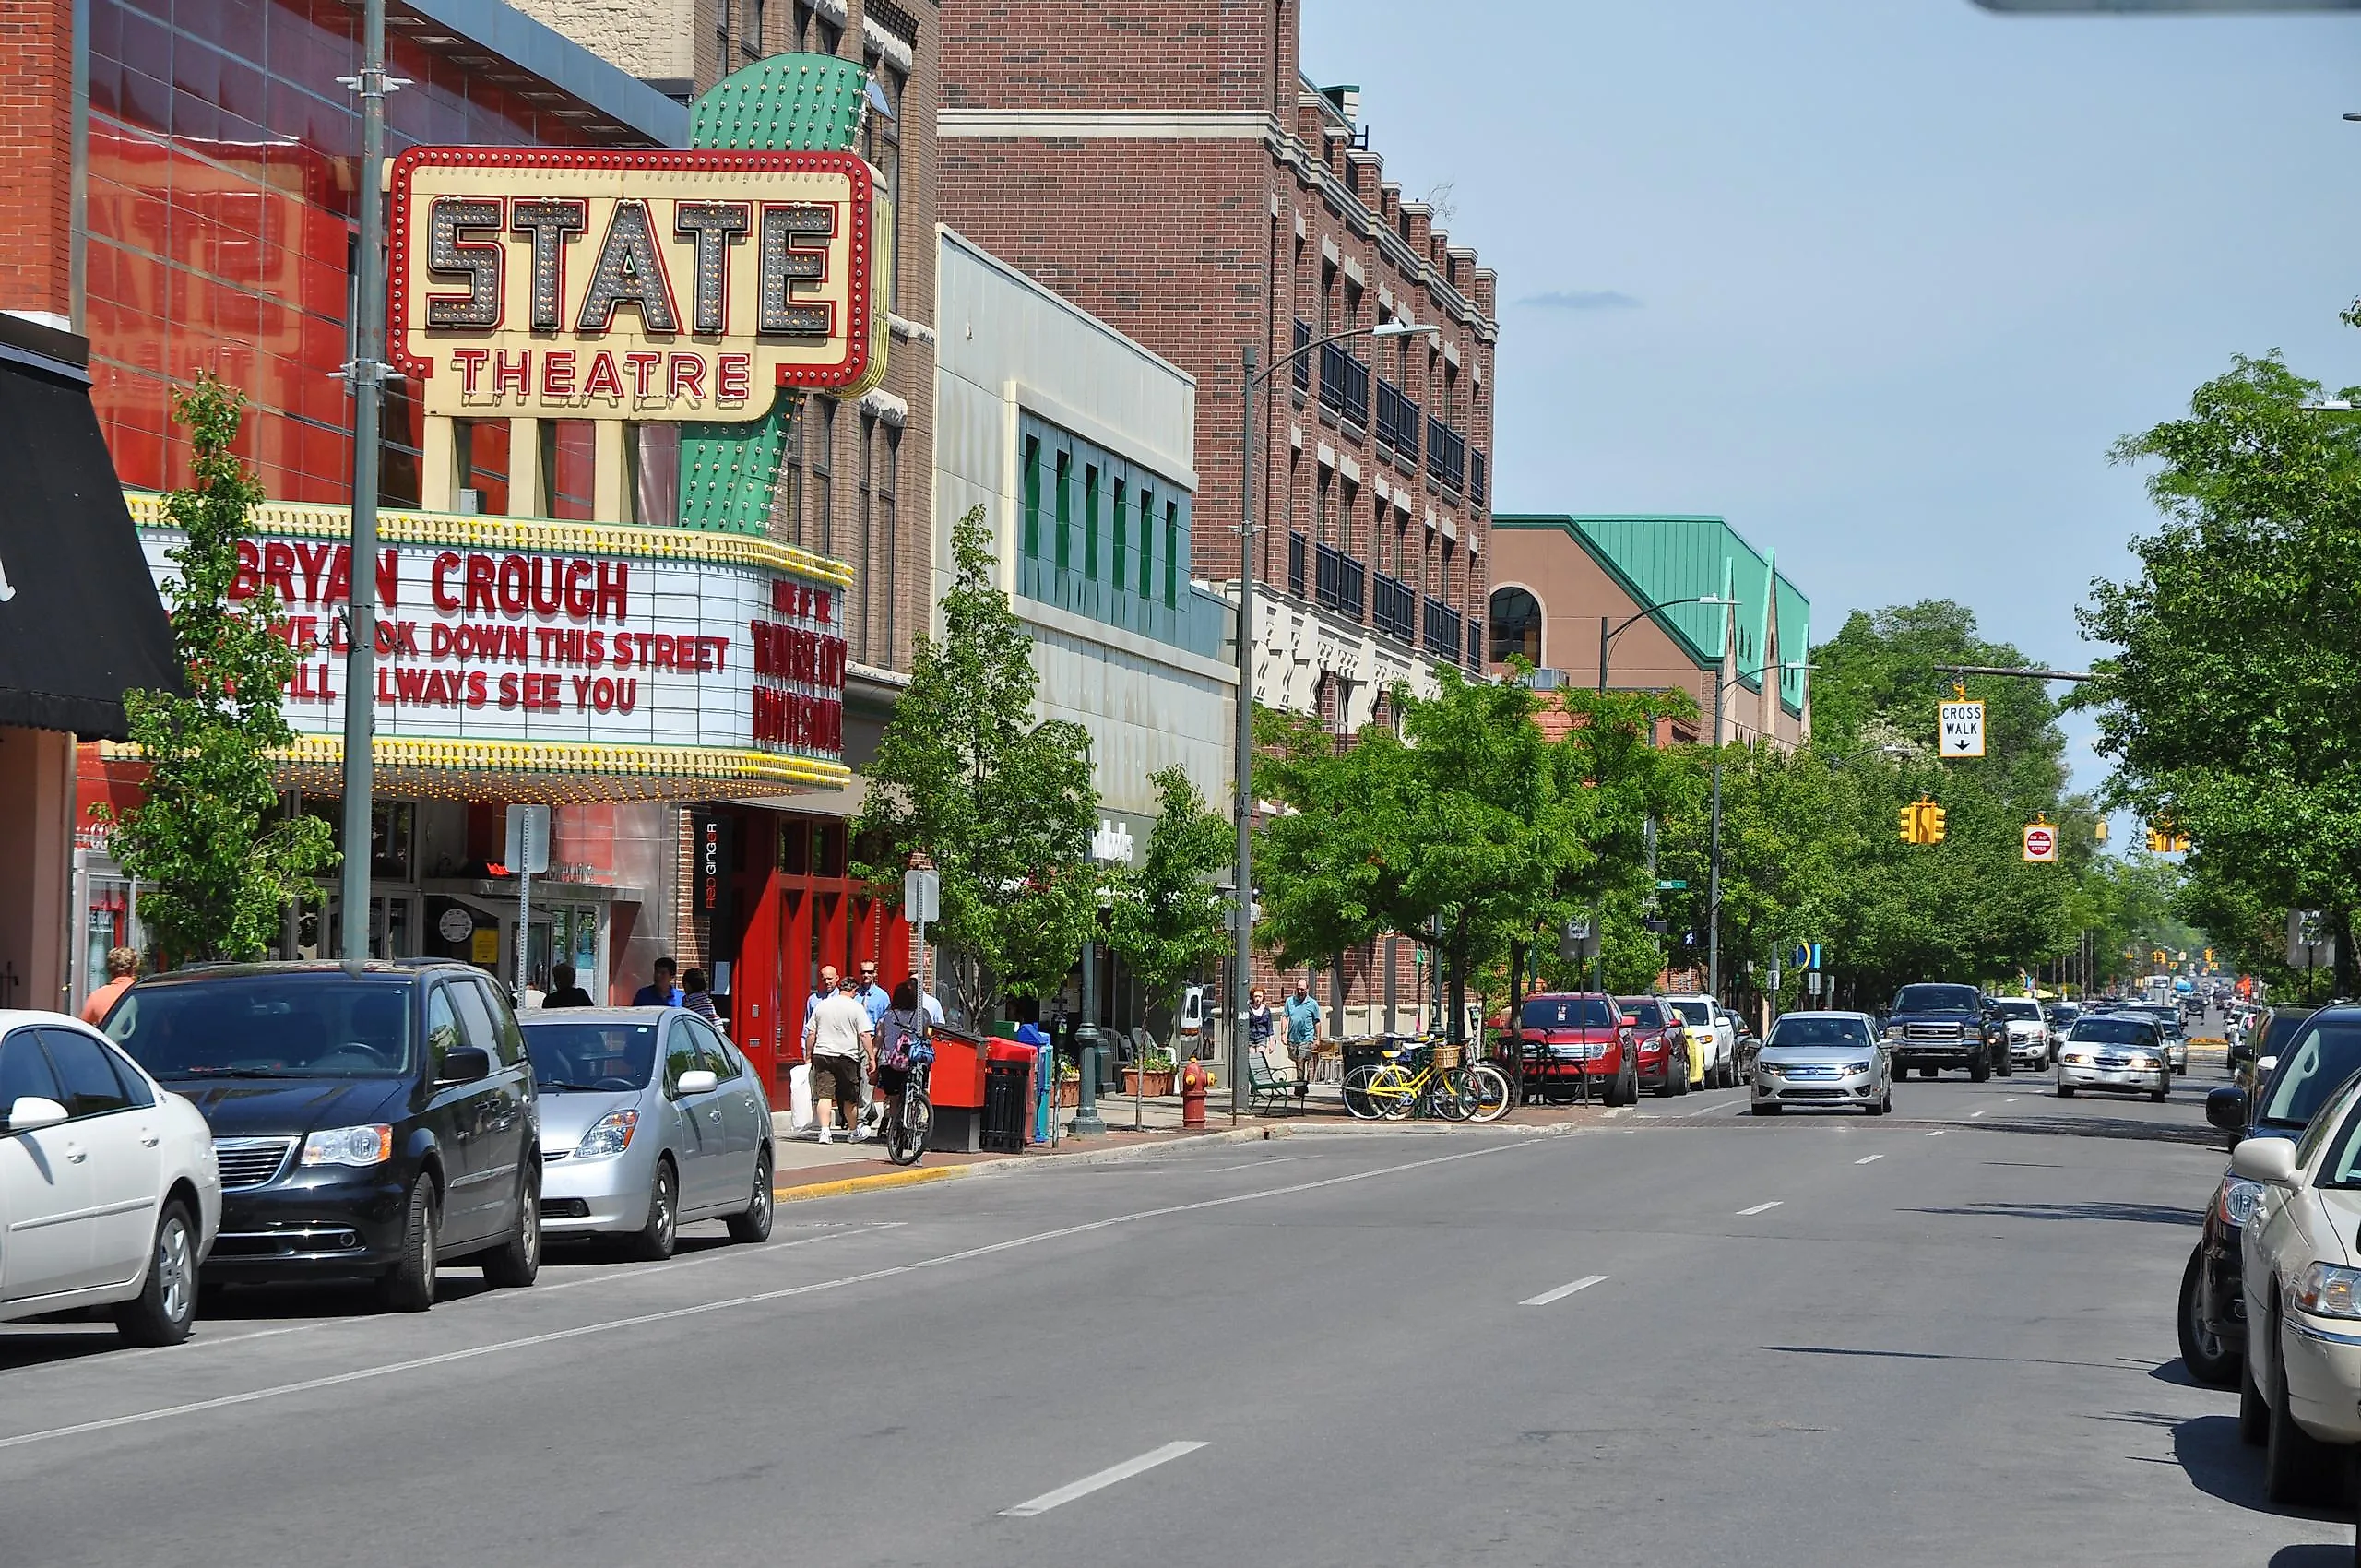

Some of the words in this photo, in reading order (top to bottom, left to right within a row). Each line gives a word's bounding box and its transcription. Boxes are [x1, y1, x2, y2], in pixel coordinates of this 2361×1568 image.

[426, 196, 837, 335] STATE
[453, 348, 751, 400] THEATRE
[228, 540, 398, 608] BRYAN
[433, 553, 628, 620] CROUGH
[332, 616, 419, 657] LOK
[431, 623, 527, 661] DOWN
[535, 626, 605, 667] THIS
[613, 632, 730, 674] STREET
[279, 662, 335, 698] ILL
[376, 667, 488, 710] LWAYS
[499, 672, 562, 710] SEE
[573, 675, 636, 714] YOU
[1942, 707, 1981, 719] CROSS
[1946, 722, 1977, 735] WALK
